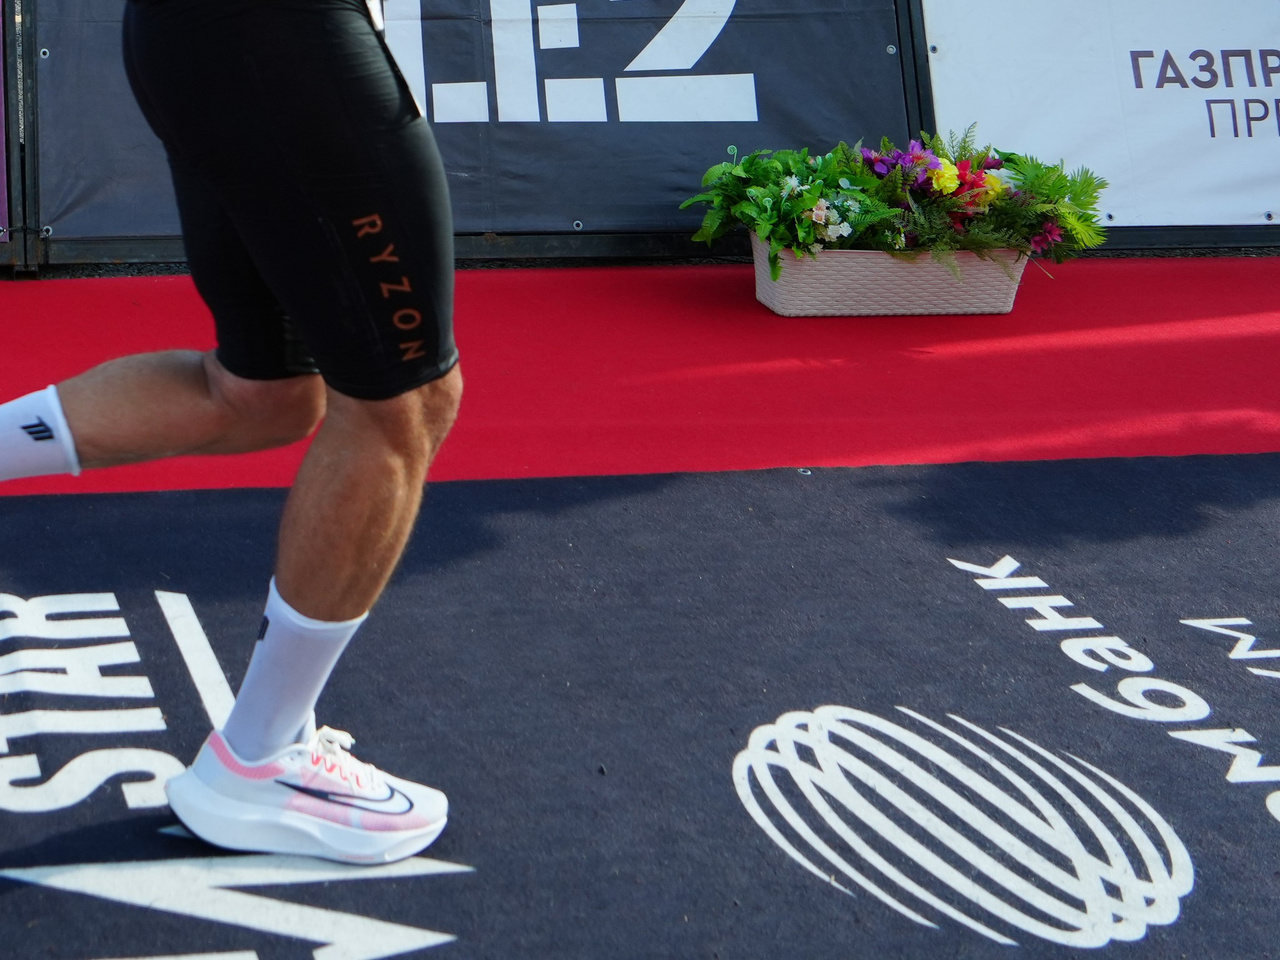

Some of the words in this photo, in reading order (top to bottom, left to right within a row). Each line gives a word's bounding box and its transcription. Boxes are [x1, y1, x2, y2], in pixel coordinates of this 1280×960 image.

[1129, 48, 1280, 89] ГАЗПР
[1205, 98, 1280, 138] ПР
[352, 213, 426, 361] RYZON
[946, 555, 1280, 826] мбанк
